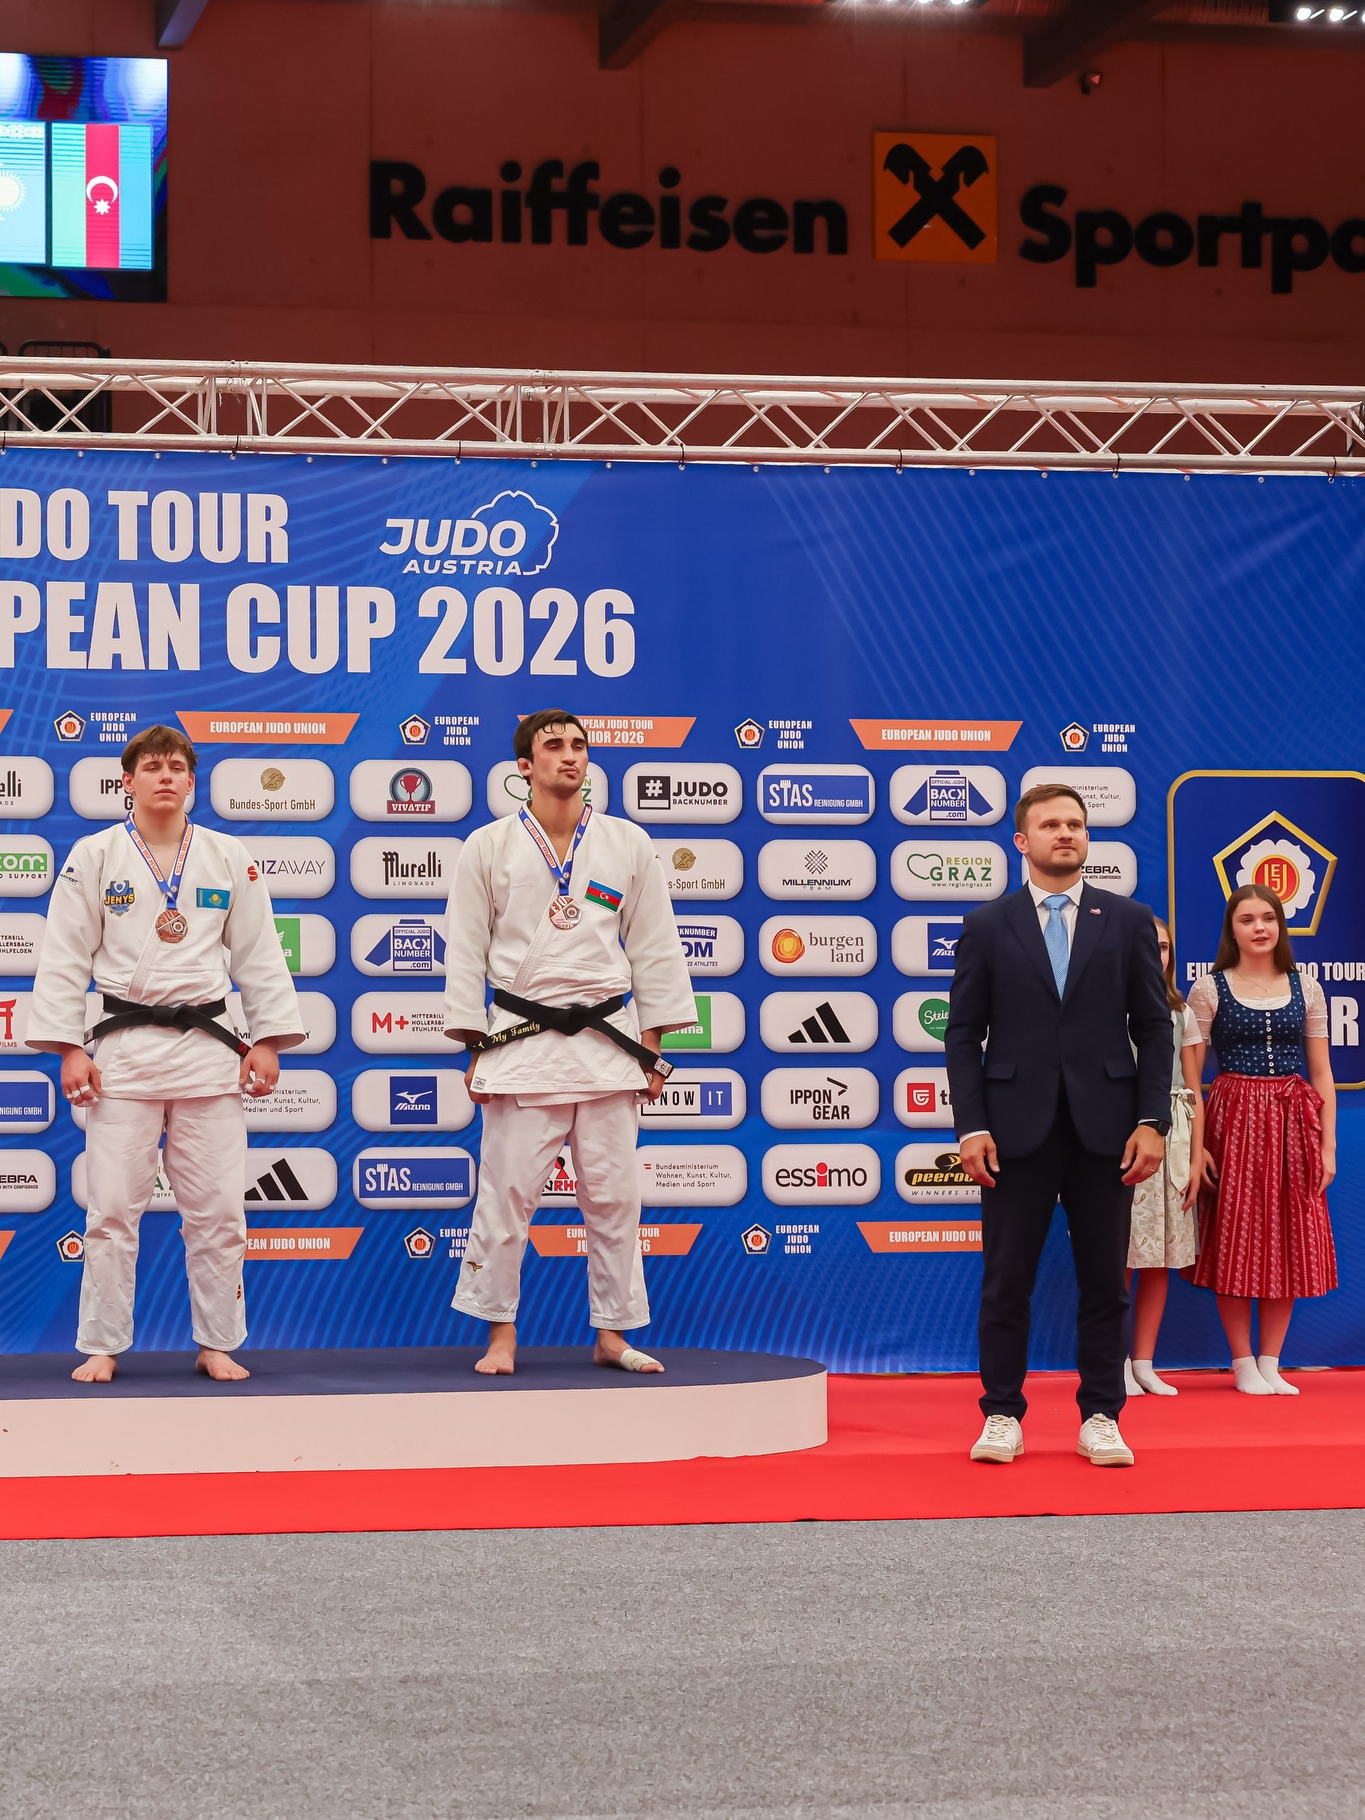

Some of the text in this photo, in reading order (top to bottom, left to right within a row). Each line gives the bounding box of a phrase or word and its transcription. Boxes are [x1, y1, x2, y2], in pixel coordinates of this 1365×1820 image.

[369, 160, 847, 254] Raiffeisen
[108, 491, 289, 564] TOUR
[379, 518, 527, 558] JUDO
[402, 559, 522, 575] AUSTRIA
[227, 584, 396, 674] CUP
[418, 587, 636, 677] 2026
[90, 712, 137, 722] EUROPEAN
[102, 722, 125, 733] JUDO
[210, 721, 326, 735] EUROPEAN JUDO UNION
[768, 720, 813, 730] EUROPEAN
[1093, 723, 1136, 734] EUROPEAN
[99, 733, 128, 743] UNION
[779, 730, 802, 740] JUDO
[881, 728, 991, 742] EUROPEAN JUDO UNION
[1104, 733, 1125, 743] JUDO
[777, 740, 805, 750] UNION
[1101, 743, 1128, 753] UNION
[672, 781, 728, 797] JUDO
[769, 780, 864, 808] STAS REINIGUNG GMBH
[930, 789, 965, 800] BACK
[229, 798, 315, 811] Bundes-Sport GmbH
[391, 803, 431, 812] VIVATIP
[930, 800, 965, 808] NUMBER
[946, 857, 992, 865] REGION
[382, 851, 442, 885] Murelli
[930, 866, 992, 881] GRAZ
[104, 893, 135, 905] JENYS
[809, 932, 865, 947] burgen
[830, 948, 865, 963] land
[1321, 962, 1365, 981] TOUR
[491, 1020, 540, 1044] My Family
[790, 1089, 832, 1105] IPPON
[23, 1106, 42, 1116] GMBH
[394, 1102, 430, 1111] MIZUNO
[812, 1104, 850, 1120] GEAR
[365, 1164, 464, 1192] STAS REINIGUNG GMBH
[655, 1172, 732, 1180] Wohnen, Kunst, Kultur,
[775, 1162, 867, 1187] essimo
[697, 1181, 715, 1189] Sport
[775, 1224, 820, 1234] EUROPEAN
[786, 1235, 809, 1245] JUDO
[889, 1230, 966, 1243] EUROPEAN JUDO
[784, 1244, 812, 1255] UNION
